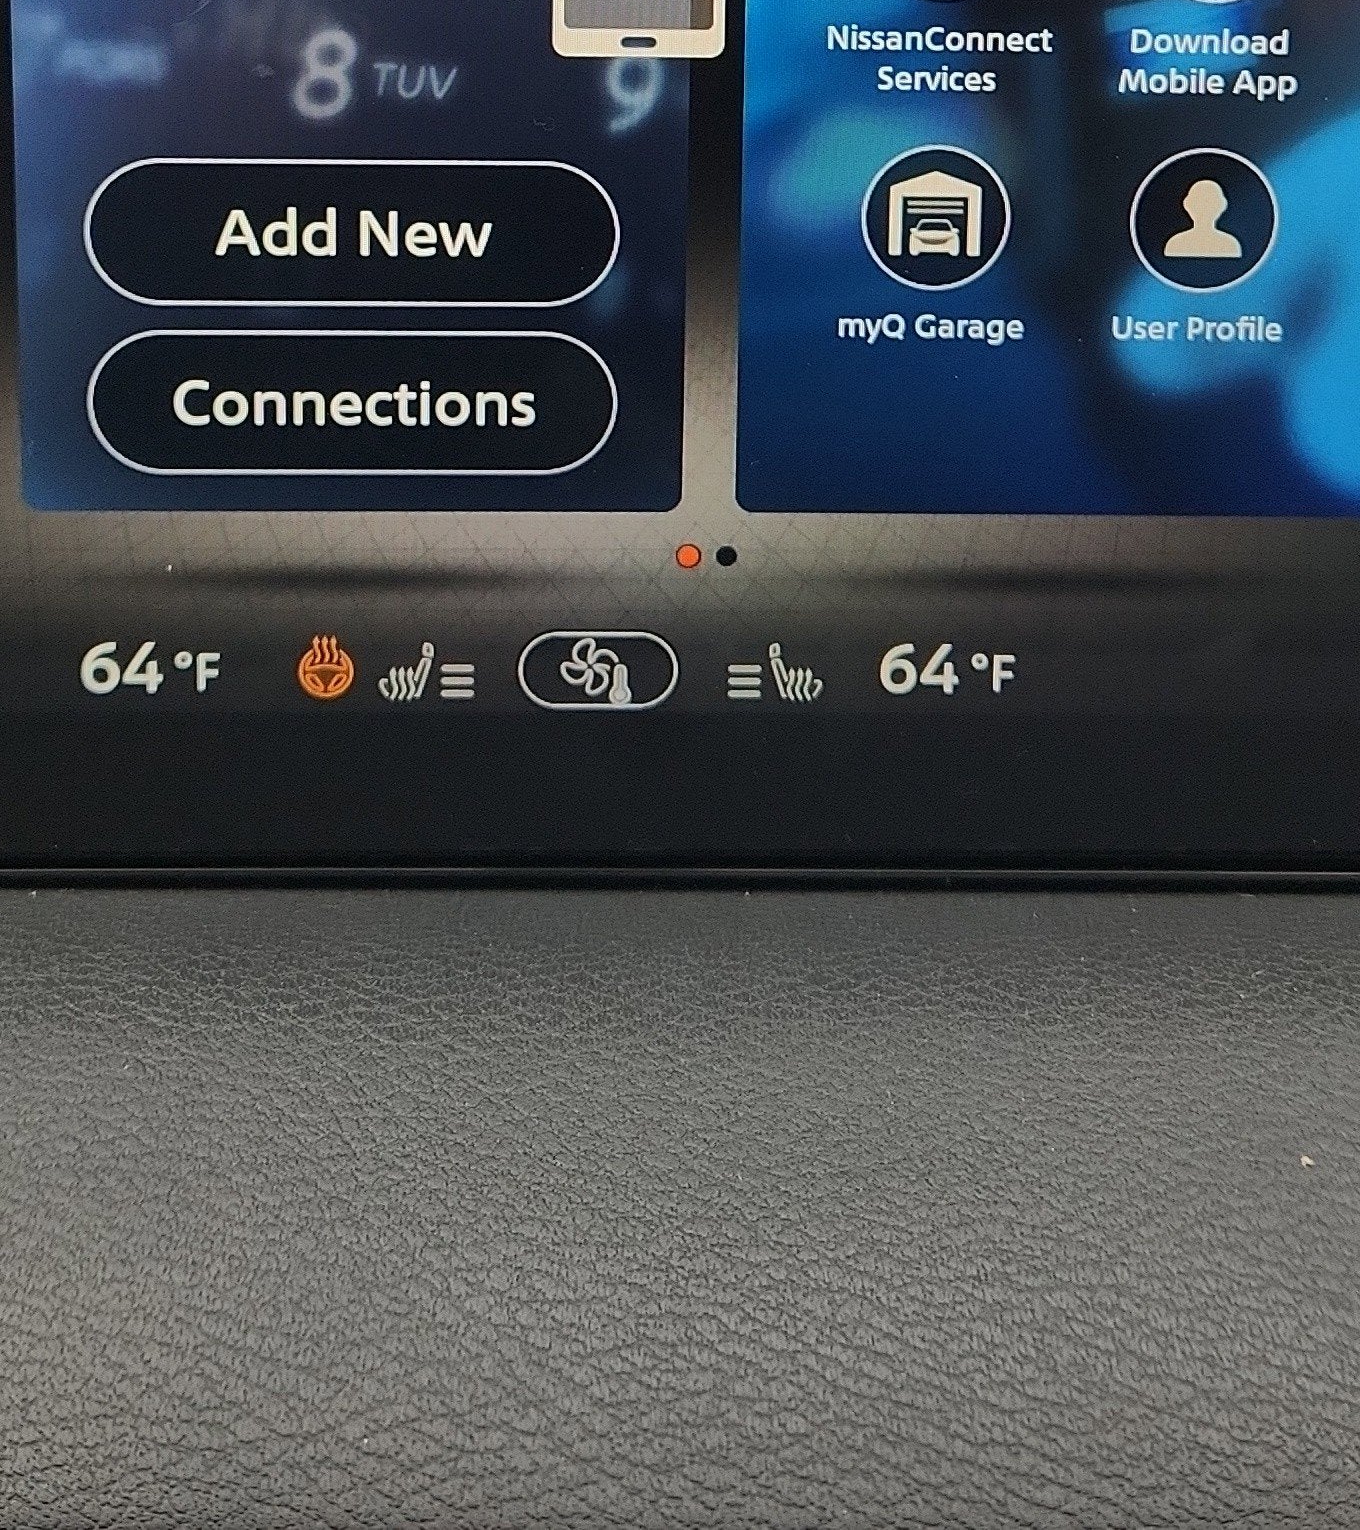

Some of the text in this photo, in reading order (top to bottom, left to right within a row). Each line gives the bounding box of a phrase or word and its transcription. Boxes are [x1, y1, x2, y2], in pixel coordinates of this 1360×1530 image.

[827, 24, 1054, 54] NissanConnect
[1130, 28, 1290, 57] Download
[293, 28, 458, 120] 8 TUV
[876, 65, 997, 94] Services
[1118, 67, 1298, 102] Mobile App
[214, 207, 493, 258] Add New
[837, 314, 1024, 345] myQ Garage
[1111, 315, 1284, 345] User Profile
[172, 379, 537, 428] Connections
[80, 641, 164, 695] 64
[879, 644, 959, 696] 64
